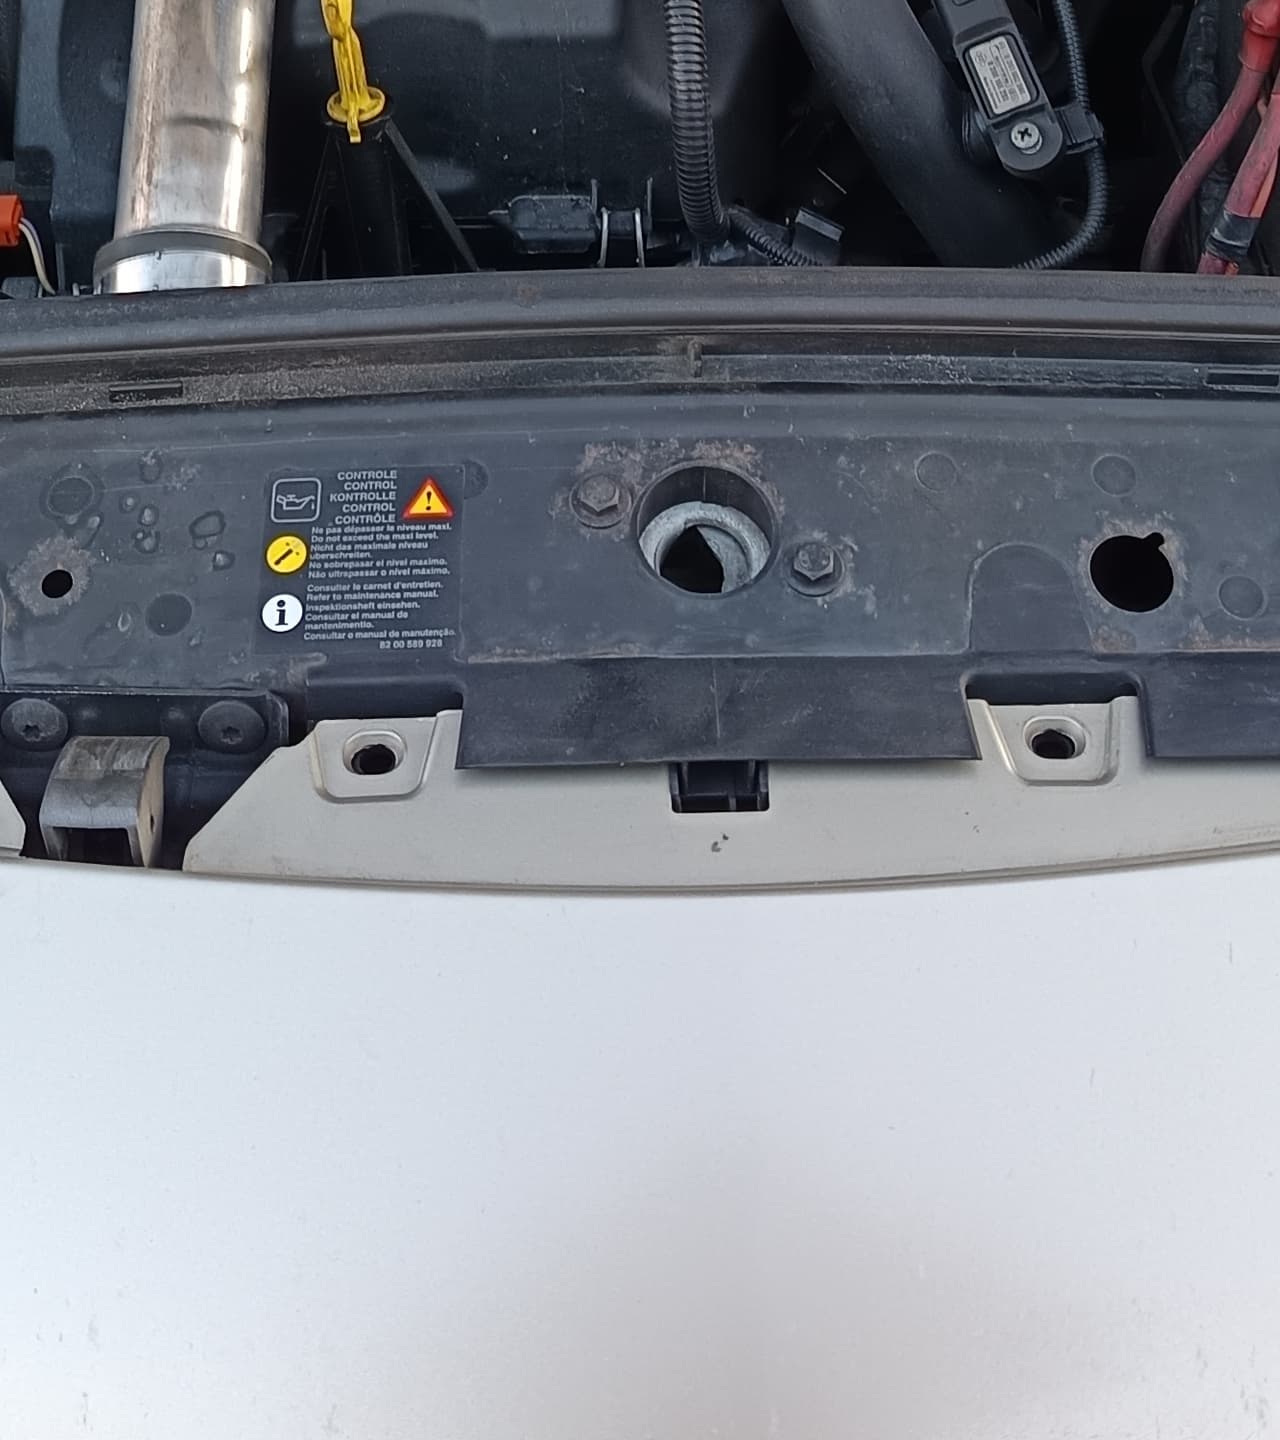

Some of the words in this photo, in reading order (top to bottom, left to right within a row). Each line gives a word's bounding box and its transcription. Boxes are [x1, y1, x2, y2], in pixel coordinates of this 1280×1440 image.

[337, 470, 397, 480] CONTROLE
[344, 481, 397, 490] CONTROL
[330, 491, 396, 502] KONTROLLE
[343, 503, 395, 513] CONTROL
[335, 512, 395, 524] CONTRÔLE
[311, 544, 333, 552] Nicht
[354, 541, 396, 550] maximale
[399, 541, 428, 549] niveau
[376, 559, 384, 567] el
[328, 570, 379, 578] ultrapassar
[307, 584, 350, 592] Consulter
[394, 581, 443, 589] d'entretien.
[344, 591, 401, 599] maintenance
[403, 590, 439, 598] manual.
[306, 602, 375, 612] Inspektionsheft
[305, 613, 349, 621] Consultar
[362, 611, 395, 619] manual
[304, 632, 346, 640] Consultar
[355, 630, 387, 638] manual
[389, 630, 399, 638] de
[380, 641, 391, 649] 82
[393, 640, 405, 648] 00
